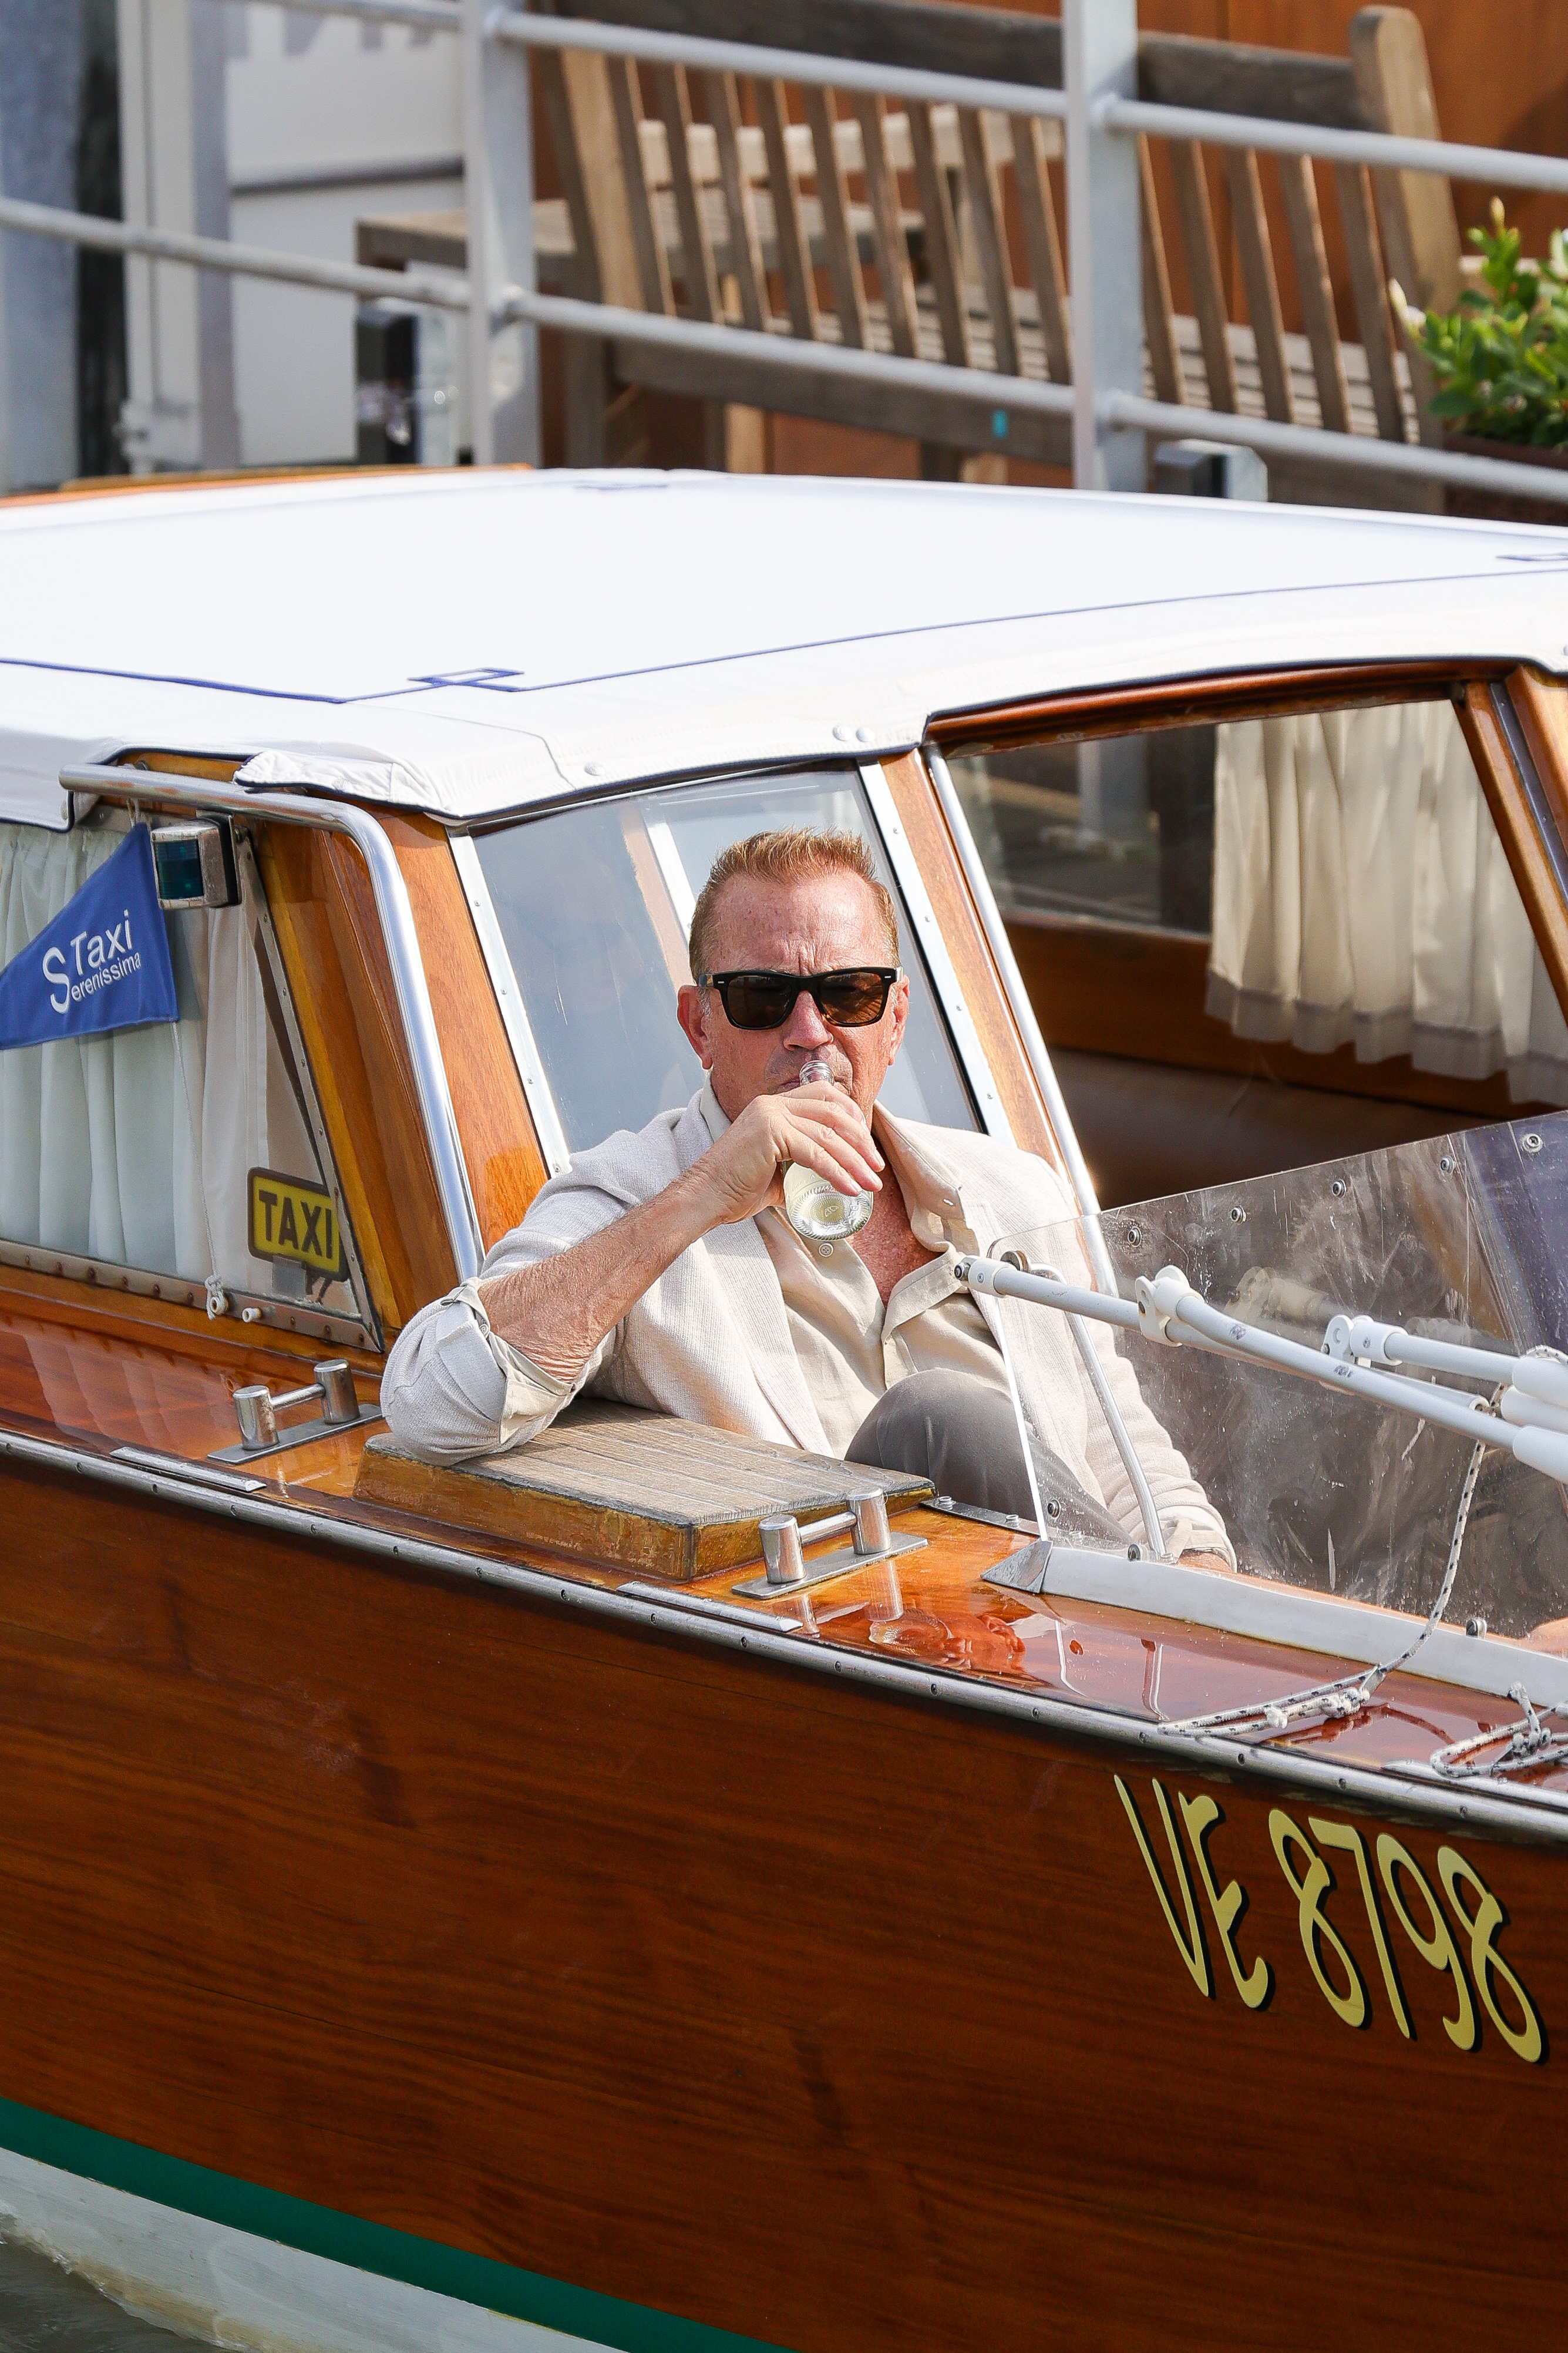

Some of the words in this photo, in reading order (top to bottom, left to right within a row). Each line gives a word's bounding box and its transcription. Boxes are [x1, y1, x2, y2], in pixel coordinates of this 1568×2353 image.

[258, 1189, 332, 1259] TAXI
[1114, 1774, 1268, 2009] VE
[1268, 1808, 1542, 2063] 8798
